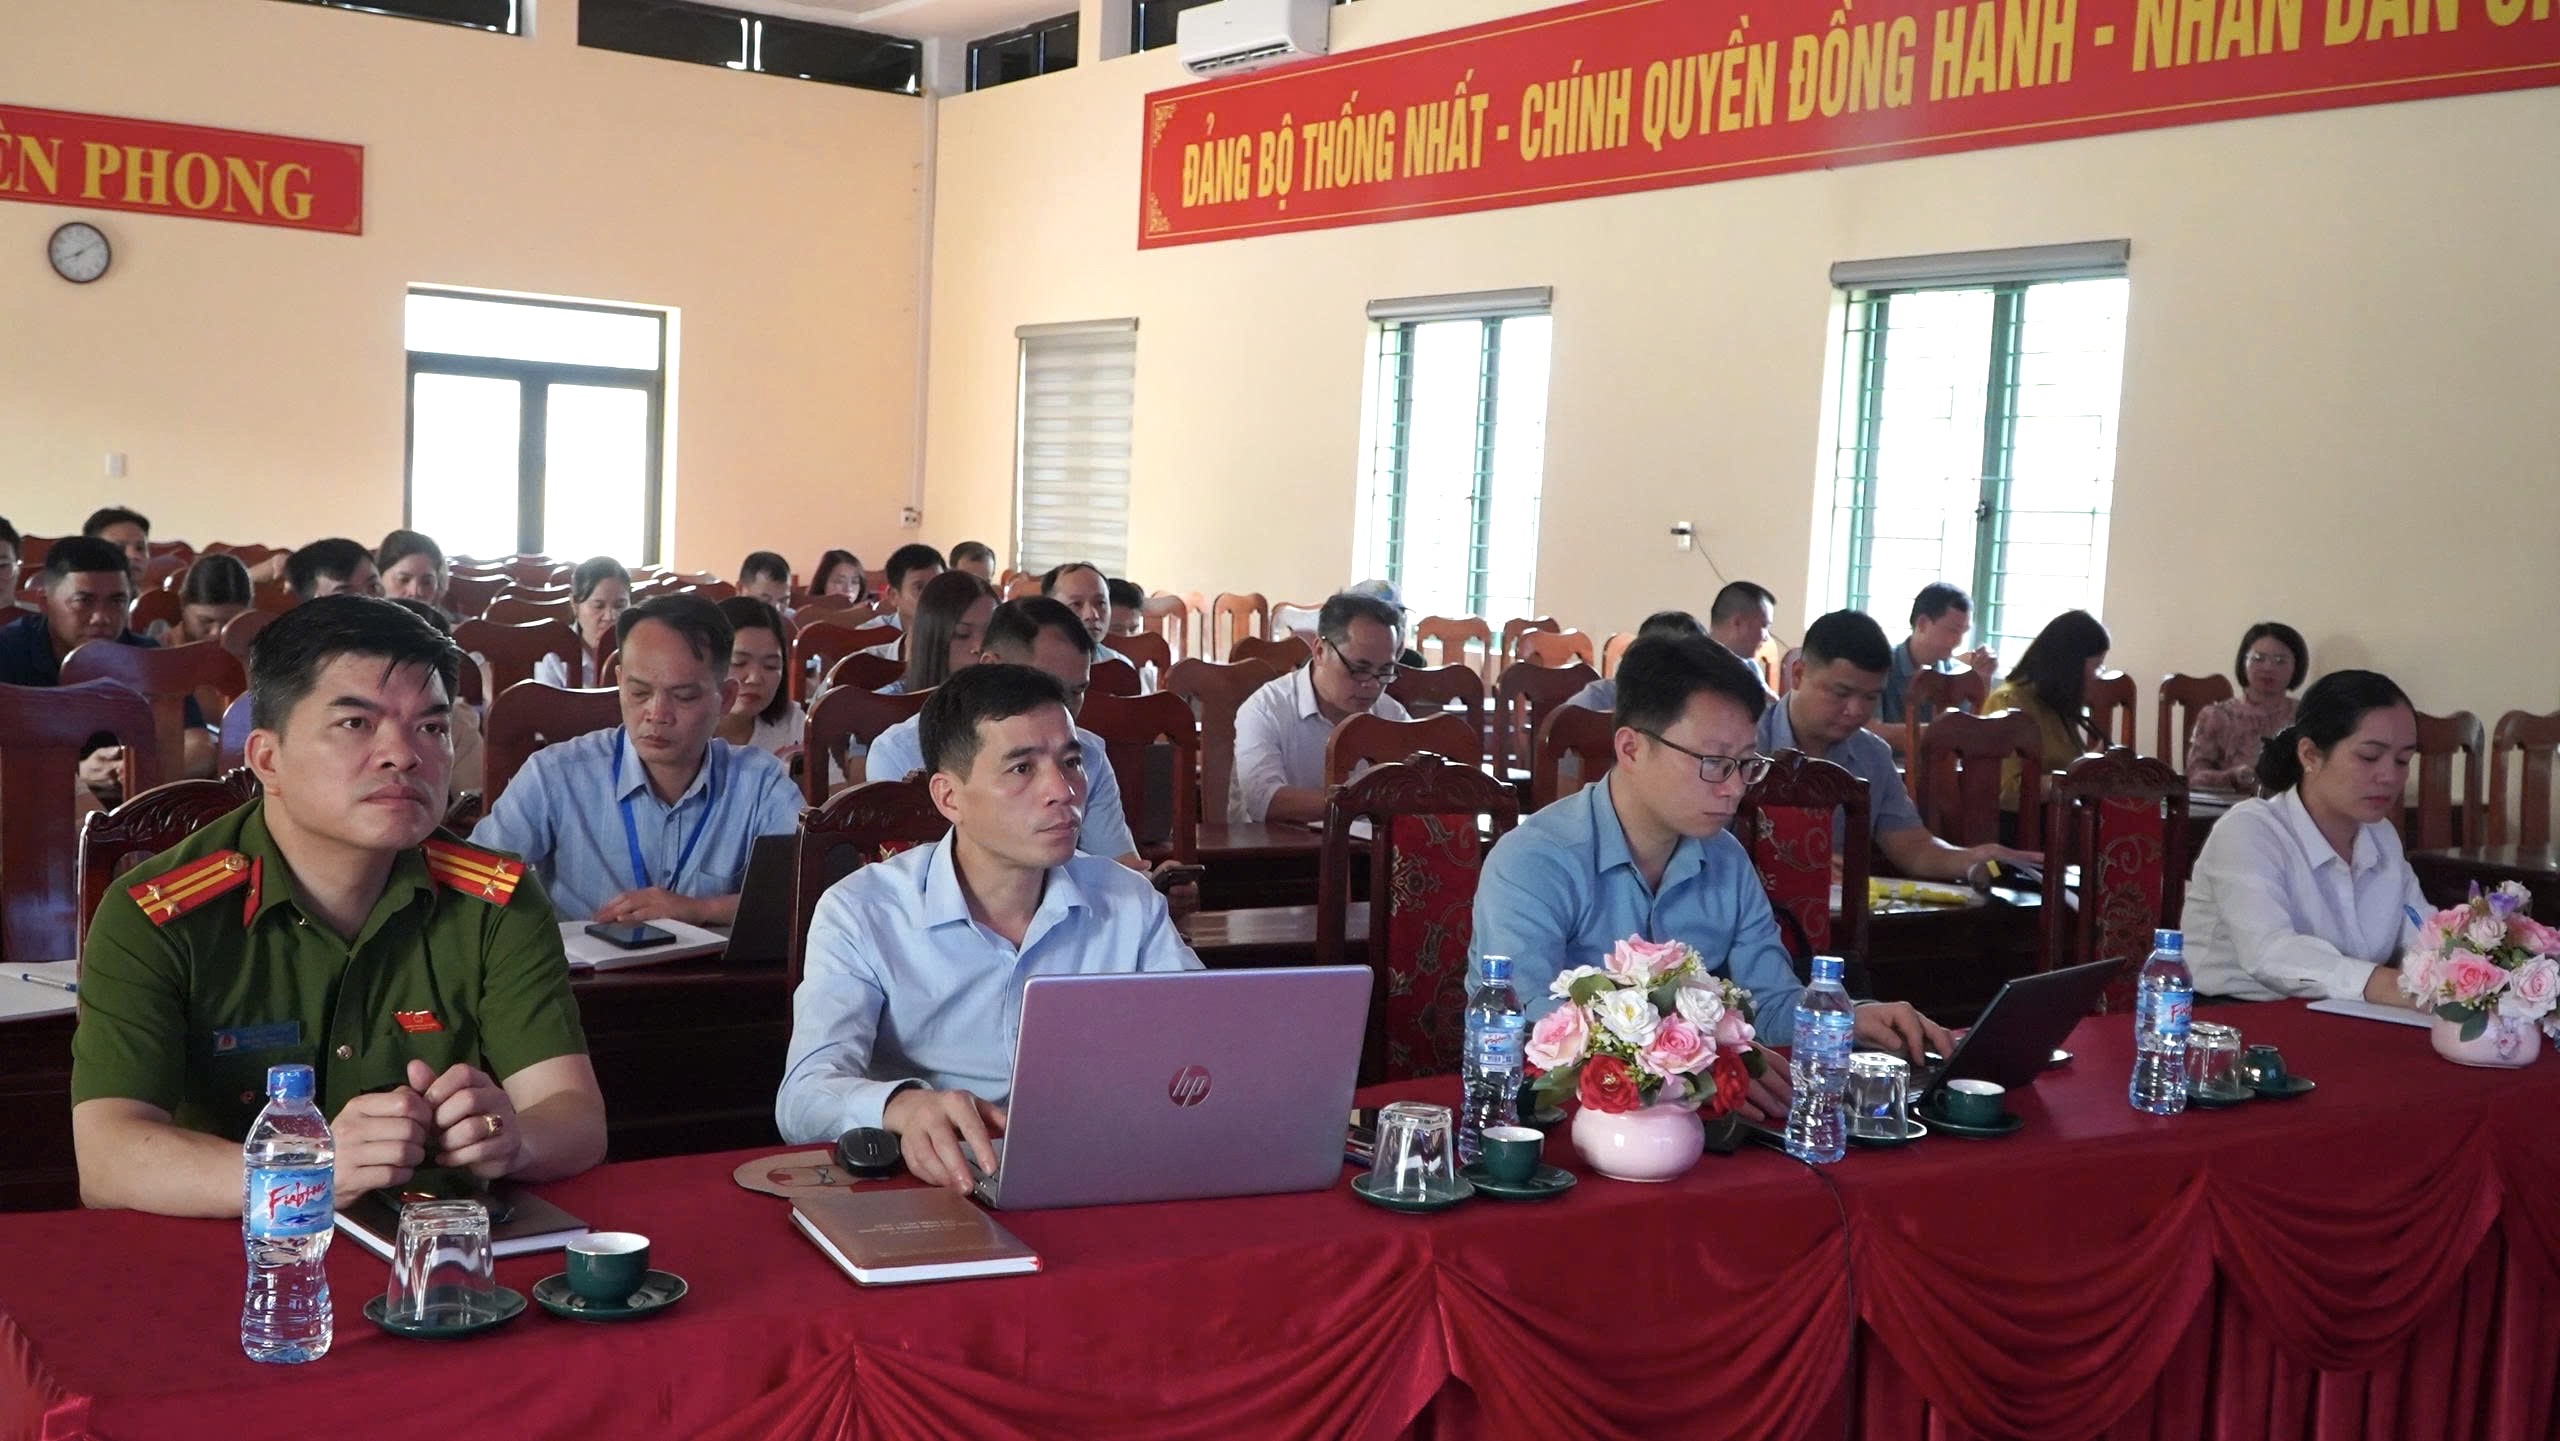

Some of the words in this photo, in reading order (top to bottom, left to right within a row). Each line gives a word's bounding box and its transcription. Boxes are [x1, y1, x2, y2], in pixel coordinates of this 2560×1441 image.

[1182, 112, 1251, 208] ĐẢNG
[1257, 113, 1294, 210] BỘ
[1302, 90, 1396, 191] THỐNG
[1403, 68, 1489, 178] NHẤT
[1519, 59, 1633, 161] CHÍNH
[1642, 15, 1778, 152] QUYỀN
[1788, 0, 1917, 122] ĐỒNG
[79, 141, 314, 220] PHONG
[1171, 1065, 1209, 1107] hp
